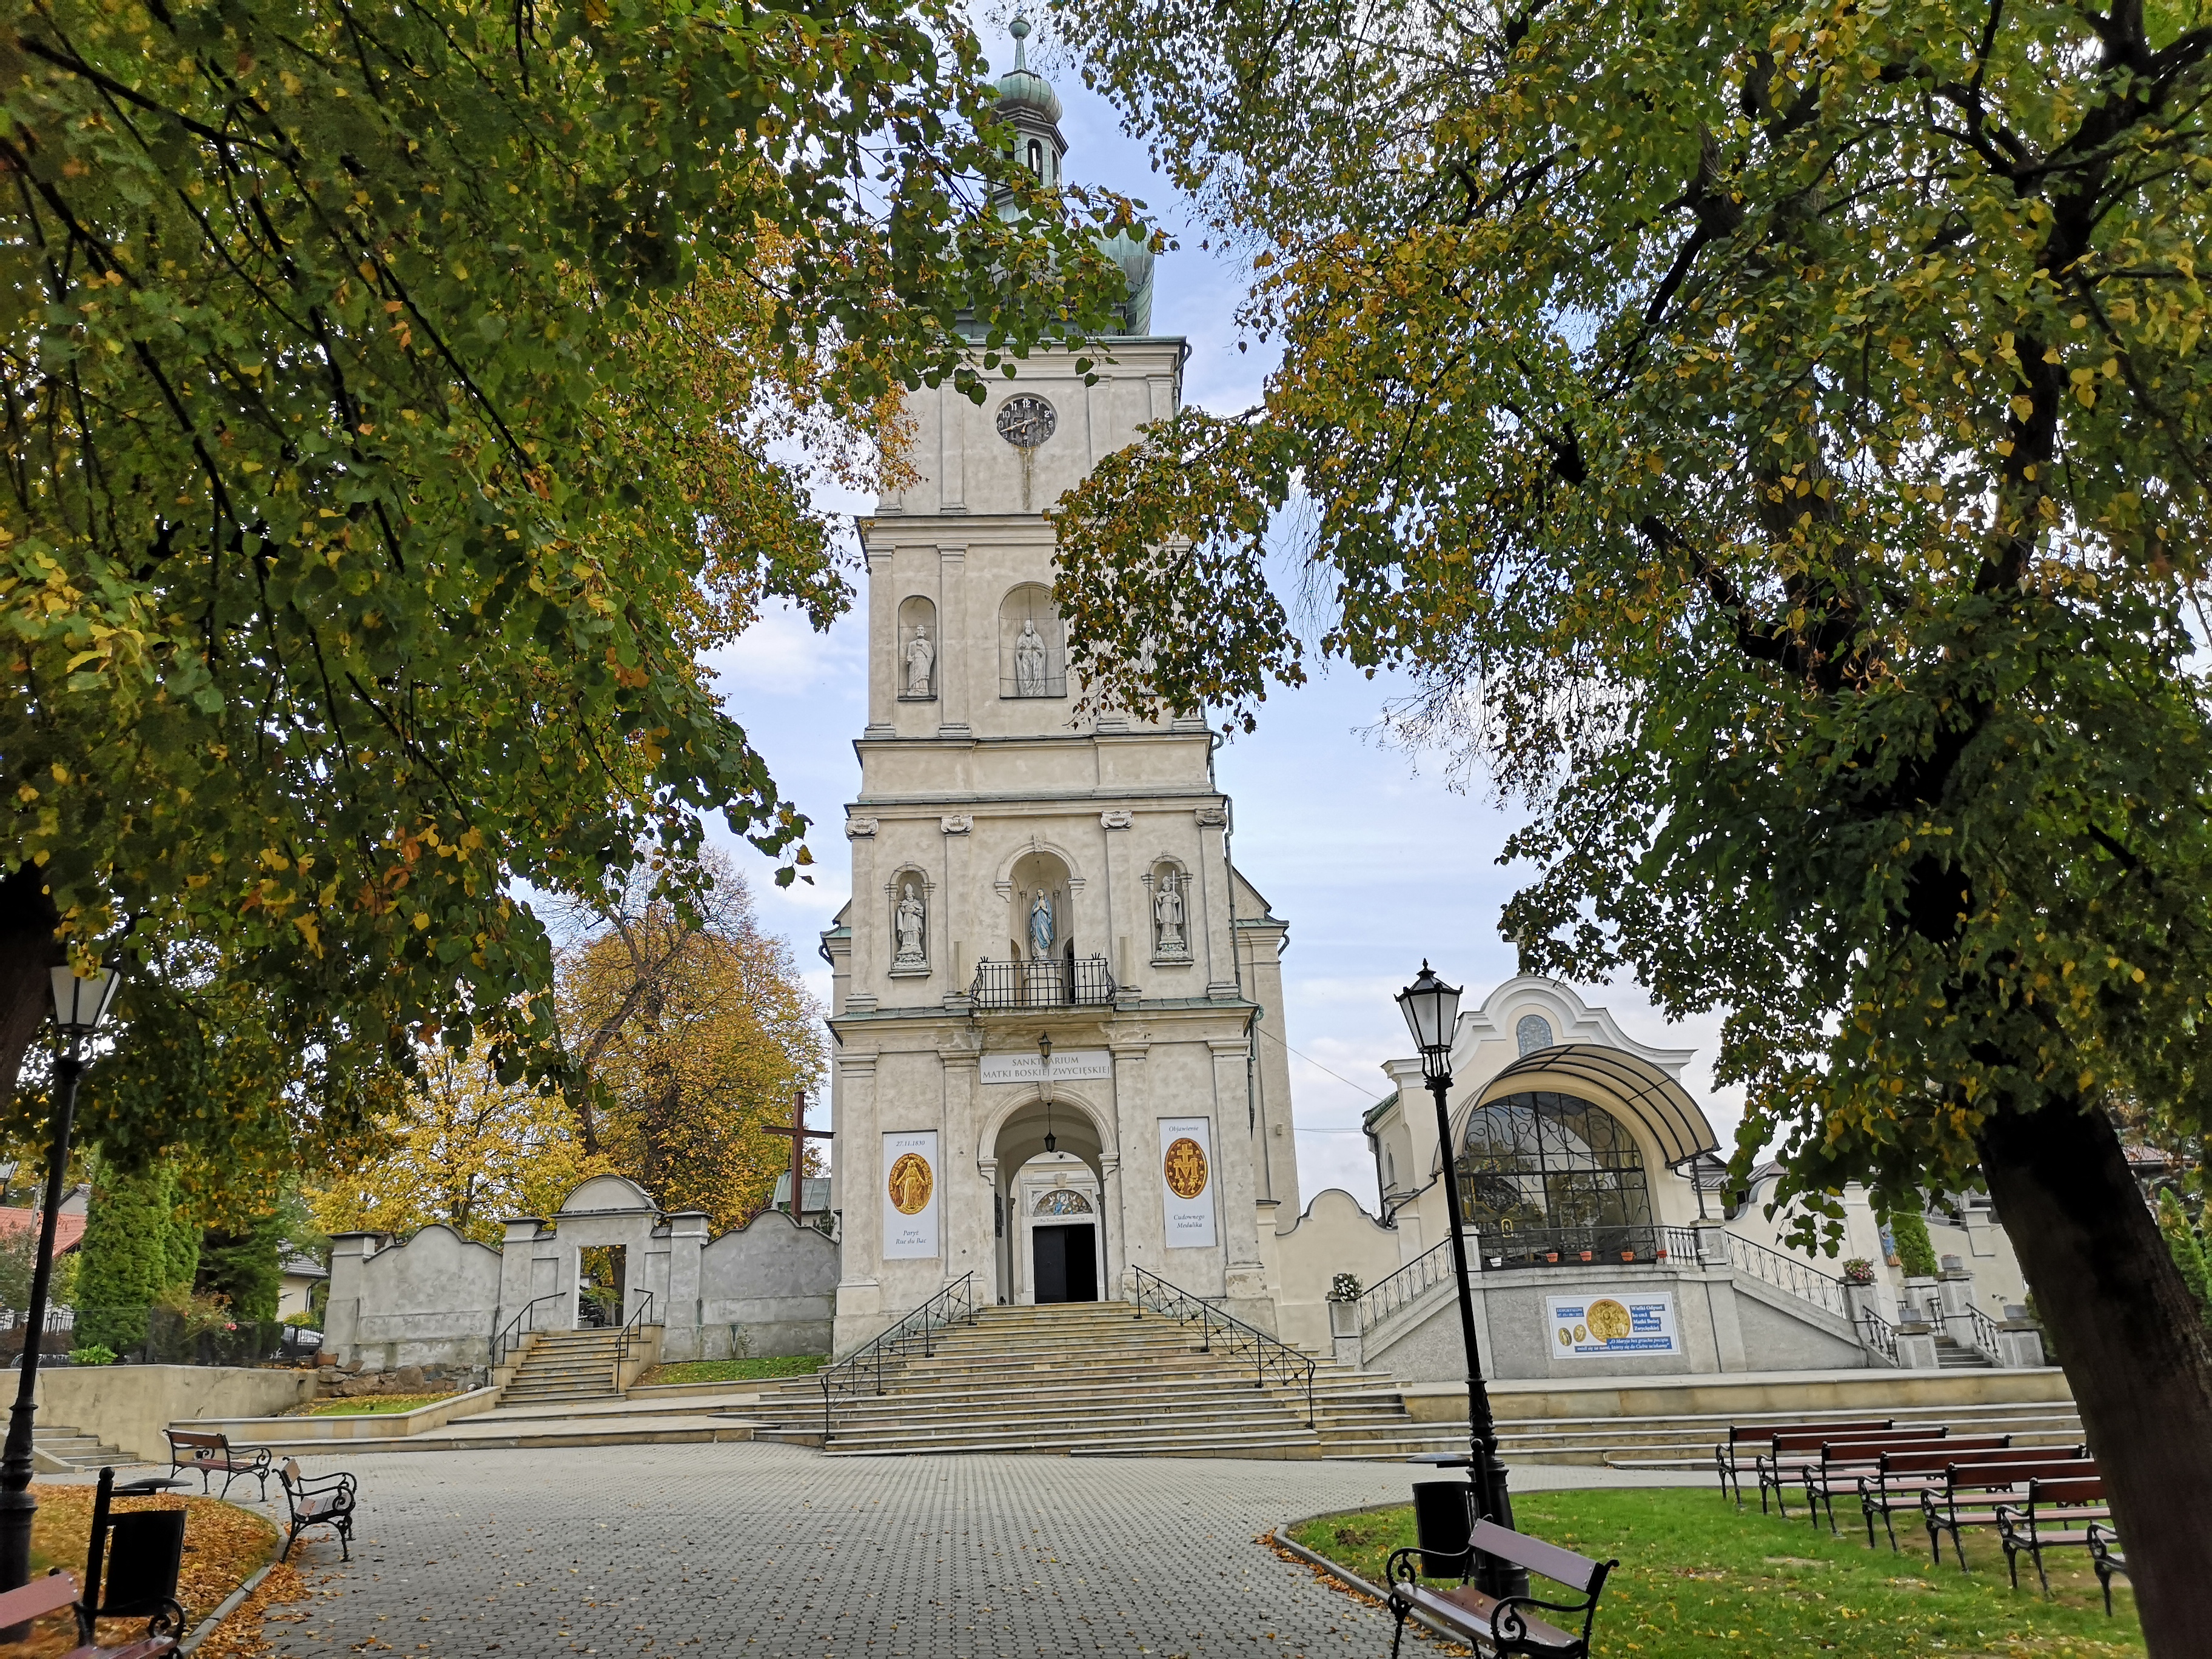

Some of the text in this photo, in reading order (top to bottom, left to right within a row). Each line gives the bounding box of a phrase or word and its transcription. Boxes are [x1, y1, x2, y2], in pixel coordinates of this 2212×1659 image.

[1010, 401, 1017, 411] 11
[1022, 400, 1031, 408] 12
[1012, 1056, 1079, 1067] SANKTUARIUM
[982, 1065, 1110, 1079] MATKI BOSKIEJ ZWYCIĘSKIEJ
